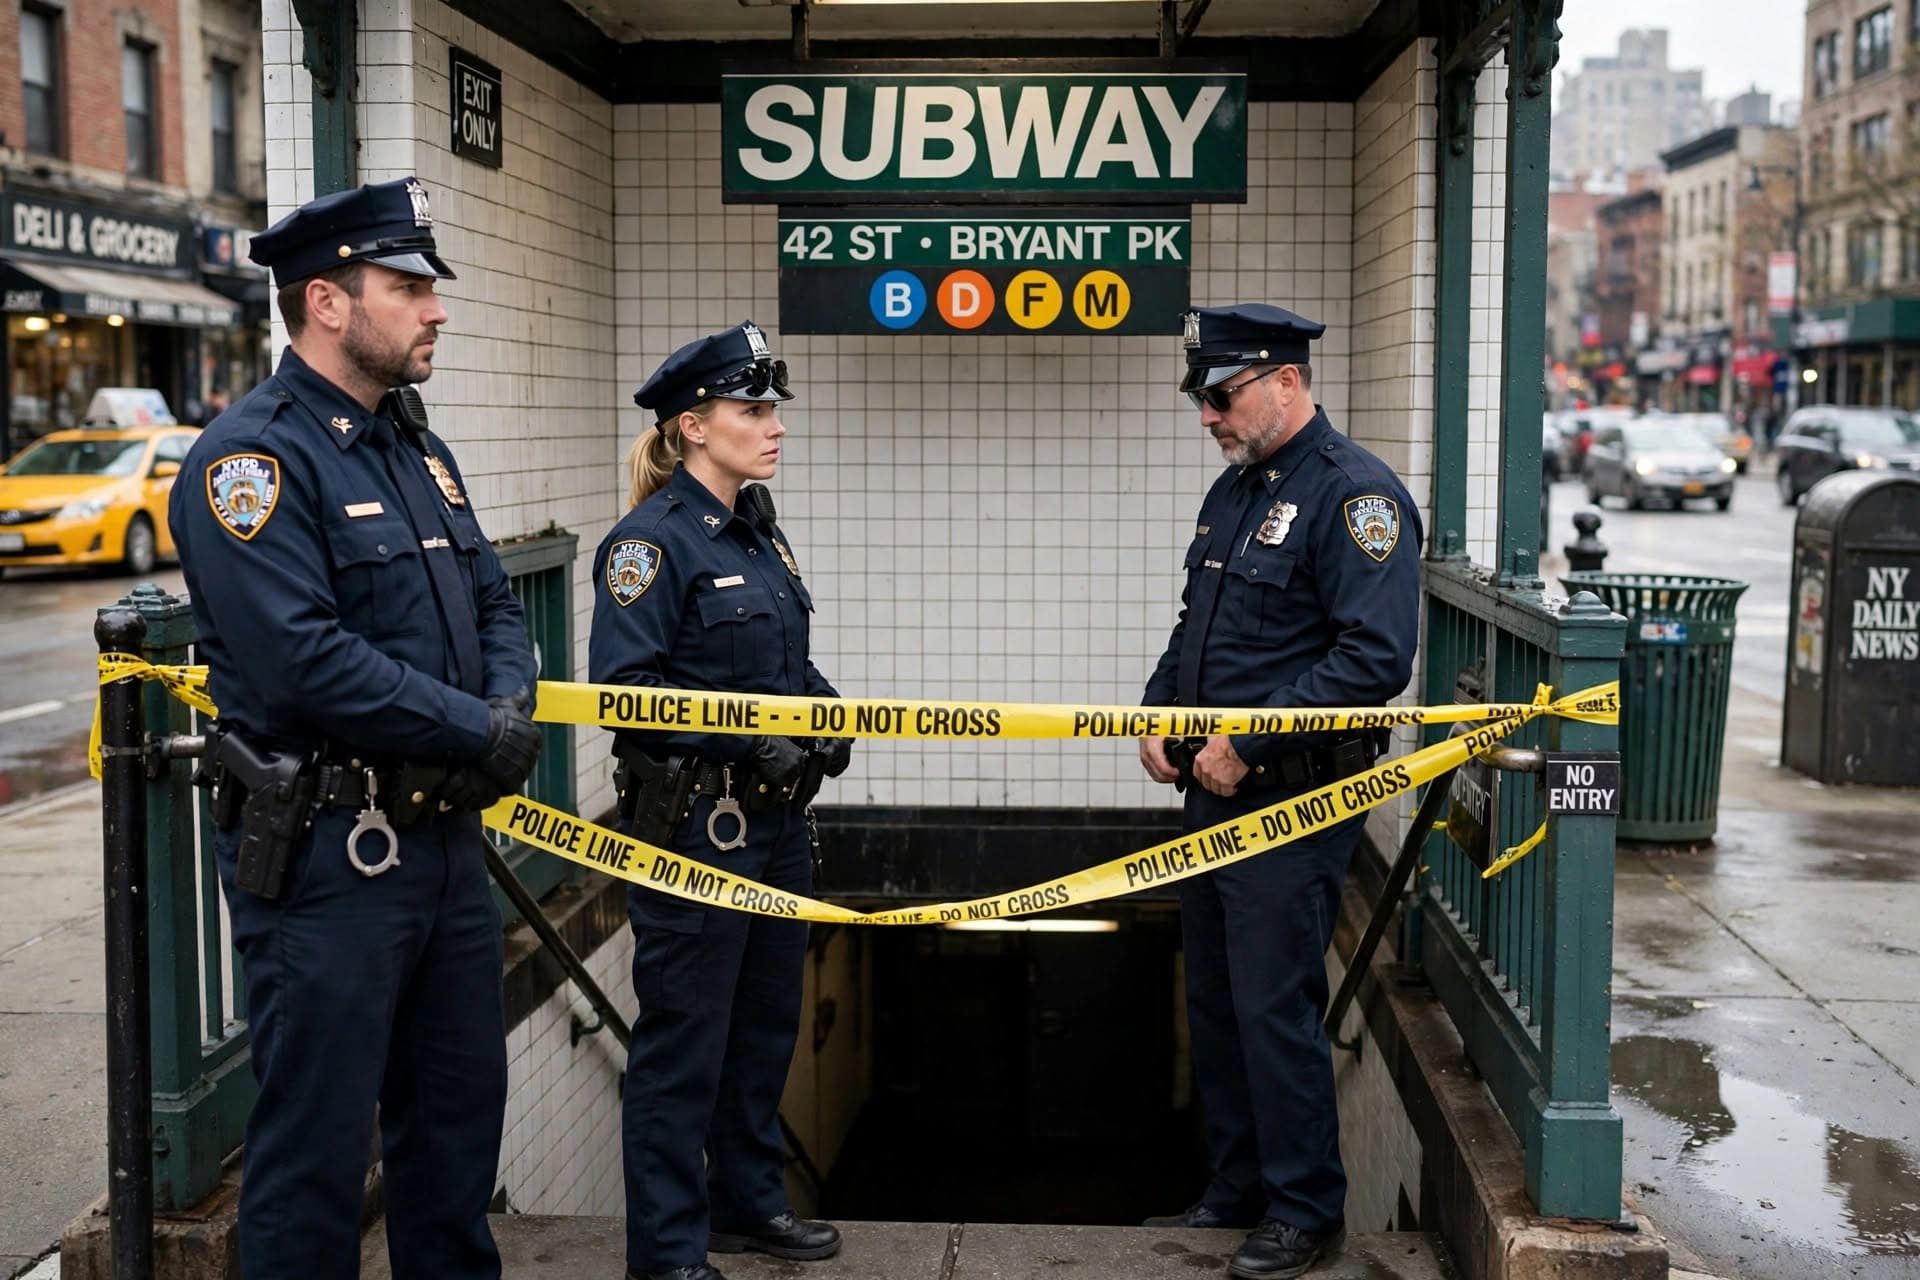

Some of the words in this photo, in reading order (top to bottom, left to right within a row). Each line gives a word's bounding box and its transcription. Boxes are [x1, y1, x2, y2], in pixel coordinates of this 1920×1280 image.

[463, 72, 492, 113] EXIT
[463, 110, 496, 151] ONLY
[738, 84, 1226, 181] SUBWAY
[14, 203, 64, 249] DELI
[68, 212, 86, 253] &
[89, 215, 179, 266] GROCERY
[783, 225, 834, 260] 42
[848, 225, 902, 260] ST
[949, 225, 1110, 260] BRYANT
[1128, 225, 1183, 260] PK
[884, 282, 912, 318] B
[951, 282, 981, 318] D
[1023, 282, 1047, 317] F
[1084, 282, 1119, 317] M
[1358, 498, 1386, 508] NYPD
[1866, 566, 1911, 599] NY
[1852, 600, 1920, 630] DAILY
[1850, 629, 1919, 660] NEWS
[599, 691, 692, 725] POLICE
[702, 696, 760, 729] LINE
[810, 702, 846, 732] DO
[855, 705, 907, 734] NOT
[915, 706, 1001, 736] CROSS
[1073, 711, 1160, 737] POLICE
[1169, 712, 1223, 735] LINE
[1249, 713, 1283, 733] DO
[1292, 712, 1340, 732] NOT
[1566, 765, 1595, 786] NO
[1550, 788, 1615, 810] ENTRY
[1124, 842, 1197, 888] POLICE
[1198, 825, 1247, 864] LINE
[1260, 809, 1292, 842] DO
[1294, 791, 1337, 830] NOT
[1341, 763, 1411, 811] CROSS
[508, 803, 585, 854] POLICE
[585, 831, 636, 872] LINE
[650, 855, 681, 888] DO
[684, 867, 728, 901] NOT
[731, 883, 798, 917] CROSS
[939, 908, 962, 921] DO
[967, 900, 1001, 920] NOT
[1007, 884, 1070, 914] CROSS
